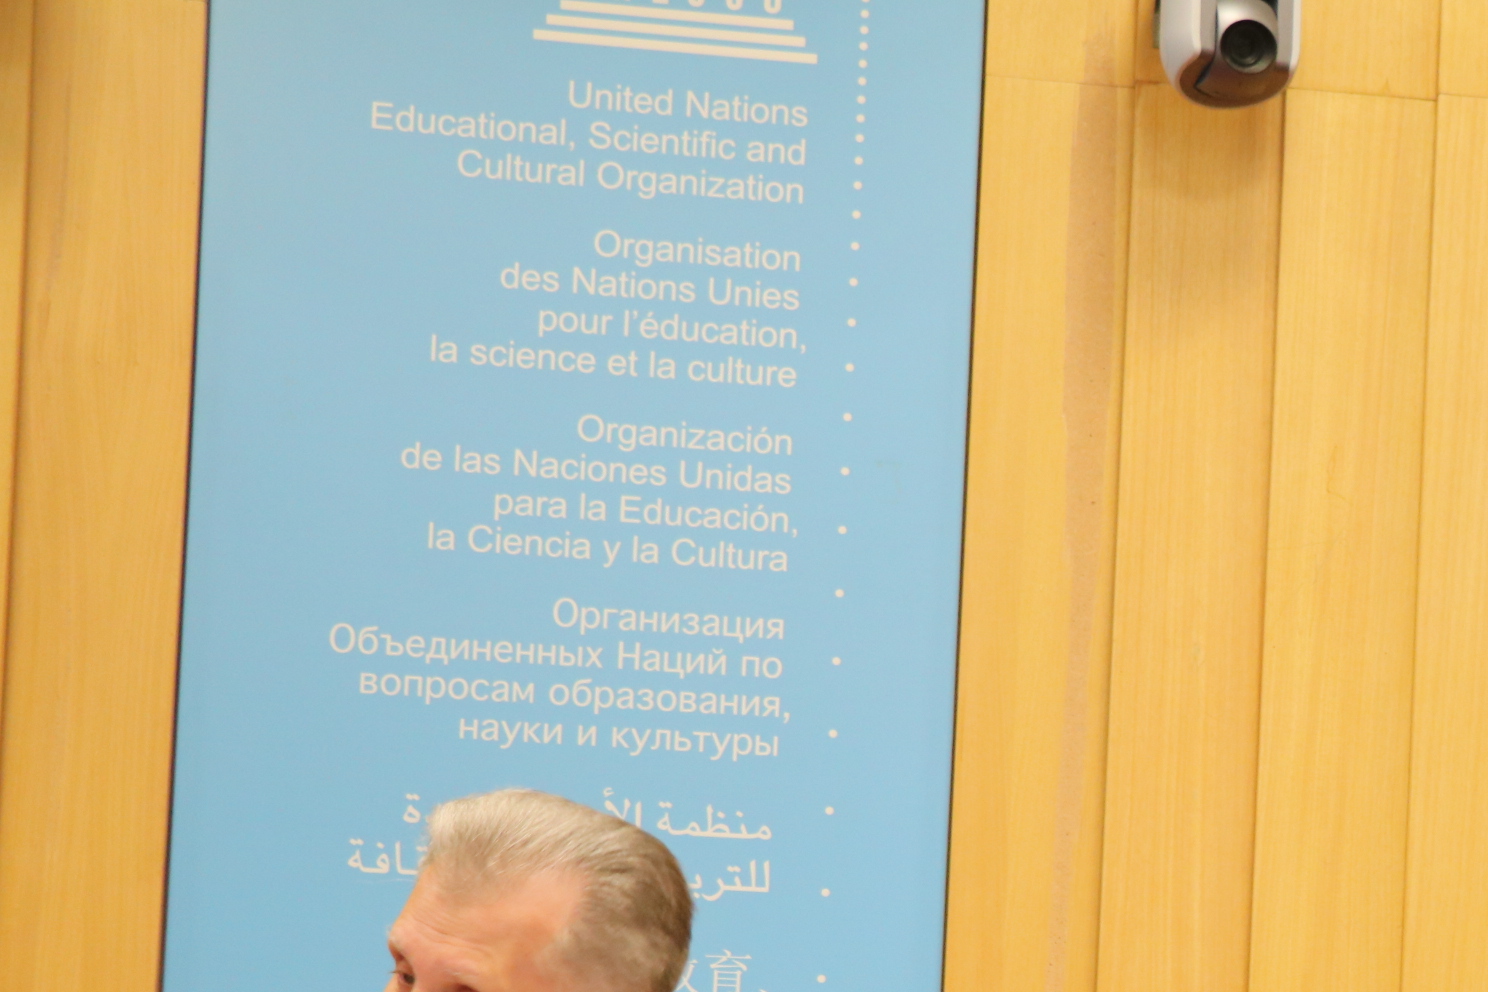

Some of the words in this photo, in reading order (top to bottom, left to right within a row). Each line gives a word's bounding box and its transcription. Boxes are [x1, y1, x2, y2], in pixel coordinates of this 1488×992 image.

[568, 79, 674, 116] United
[685, 90, 809, 128] Nations
[371, 100, 576, 151] Educational,
[588, 121, 737, 160] Scientific
[746, 138, 807, 166] and
[457, 149, 586, 186] Cultural
[596, 161, 805, 204] Organization
[593, 229, 801, 272] Organisation
[500, 261, 561, 293] des
[572, 266, 697, 303] Nations
[708, 277, 801, 311] Unies
[538, 310, 614, 337] pour
[430, 334, 458, 363] la
[470, 340, 597, 374] science
[607, 351, 639, 377] et
[649, 351, 677, 380] la
[687, 356, 798, 388] culture
[577, 413, 793, 455] Organización
[400, 441, 443, 471] de
[454, 444, 502, 475] las
[513, 449, 668, 487] Naciones
[679, 460, 792, 495] Unidas
[493, 493, 568, 521] para
[579, 493, 607, 521] la
[619, 494, 798, 537] Educación,
[427, 521, 456, 551] la
[467, 524, 591, 560] Ciencia
[603, 540, 622, 568] y
[632, 535, 660, 564] la
[671, 537, 789, 572] Cultura
[552, 597, 785, 644] Организация
[329, 622, 603, 669] Объединенных
[617, 641, 728, 679] Наций
[741, 655, 784, 679] по
[359, 672, 535, 705] вопросам
[549, 678, 791, 723] образования,
[459, 718, 563, 749] науки
[577, 725, 598, 747] и
[611, 727, 779, 762] культуры
[656, 801, 772, 840] منظمة
